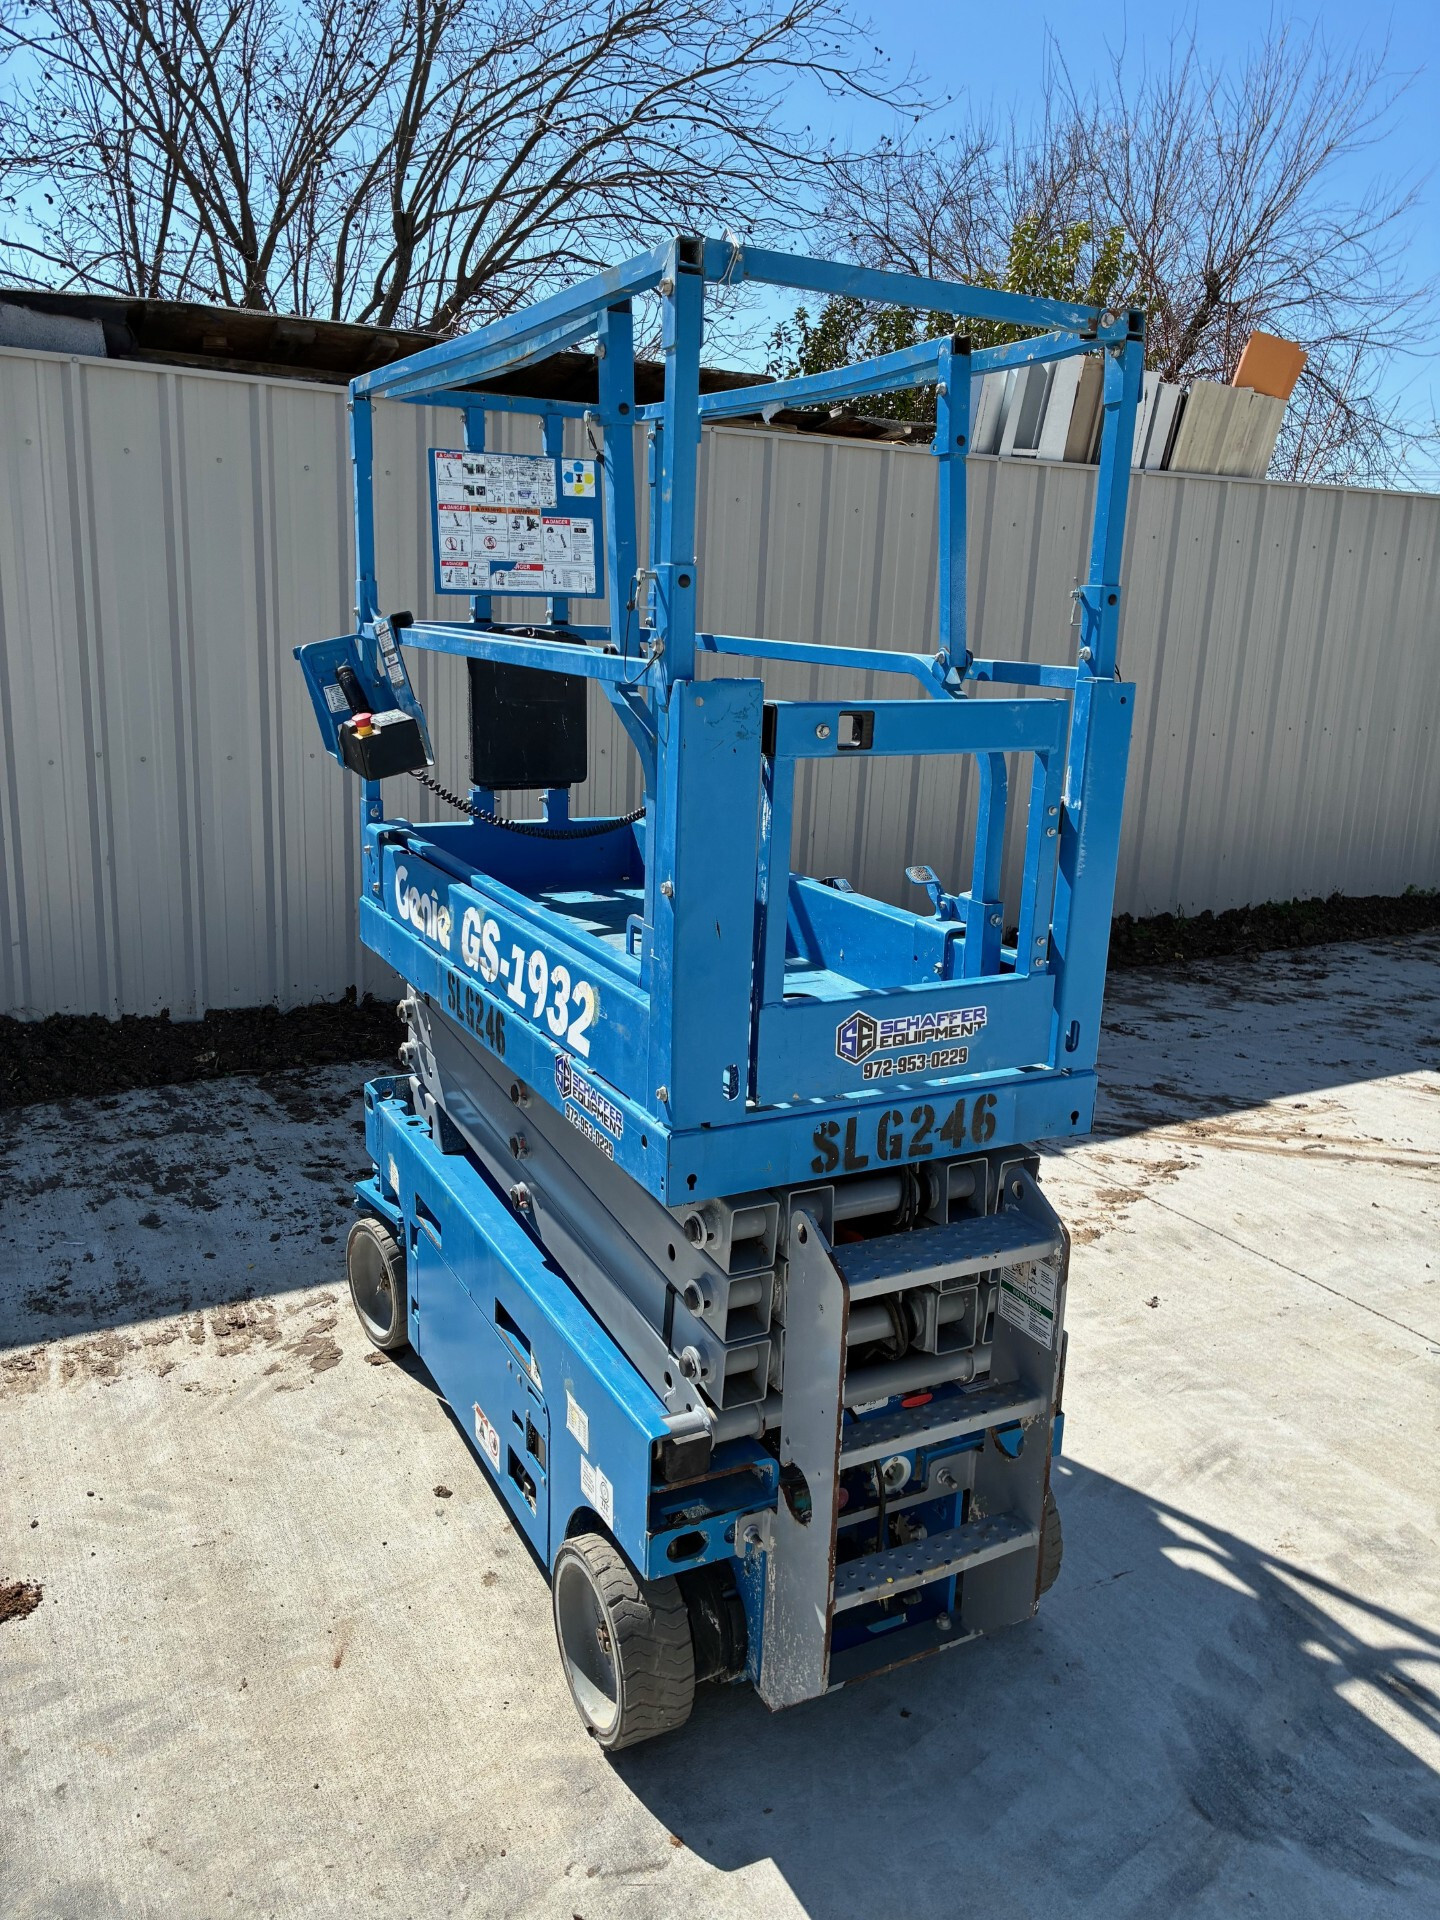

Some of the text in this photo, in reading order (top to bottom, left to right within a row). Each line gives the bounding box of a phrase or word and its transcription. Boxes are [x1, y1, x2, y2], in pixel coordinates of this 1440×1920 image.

[462, 907, 595, 1058] GS-1932
[448, 970, 506, 1057] SLG246
[879, 1021, 986, 1048] EQUIPMENT
[880, 1007, 986, 1034] SCHAFFER
[863, 1048, 968, 1079] 972-953-0229
[572, 1073, 623, 1126] SCHAFFER
[572, 1087, 623, 1139] EQUIPMENT
[566, 1102, 613, 1160] 972-953-0229
[811, 1093, 998, 1173] SLG246
